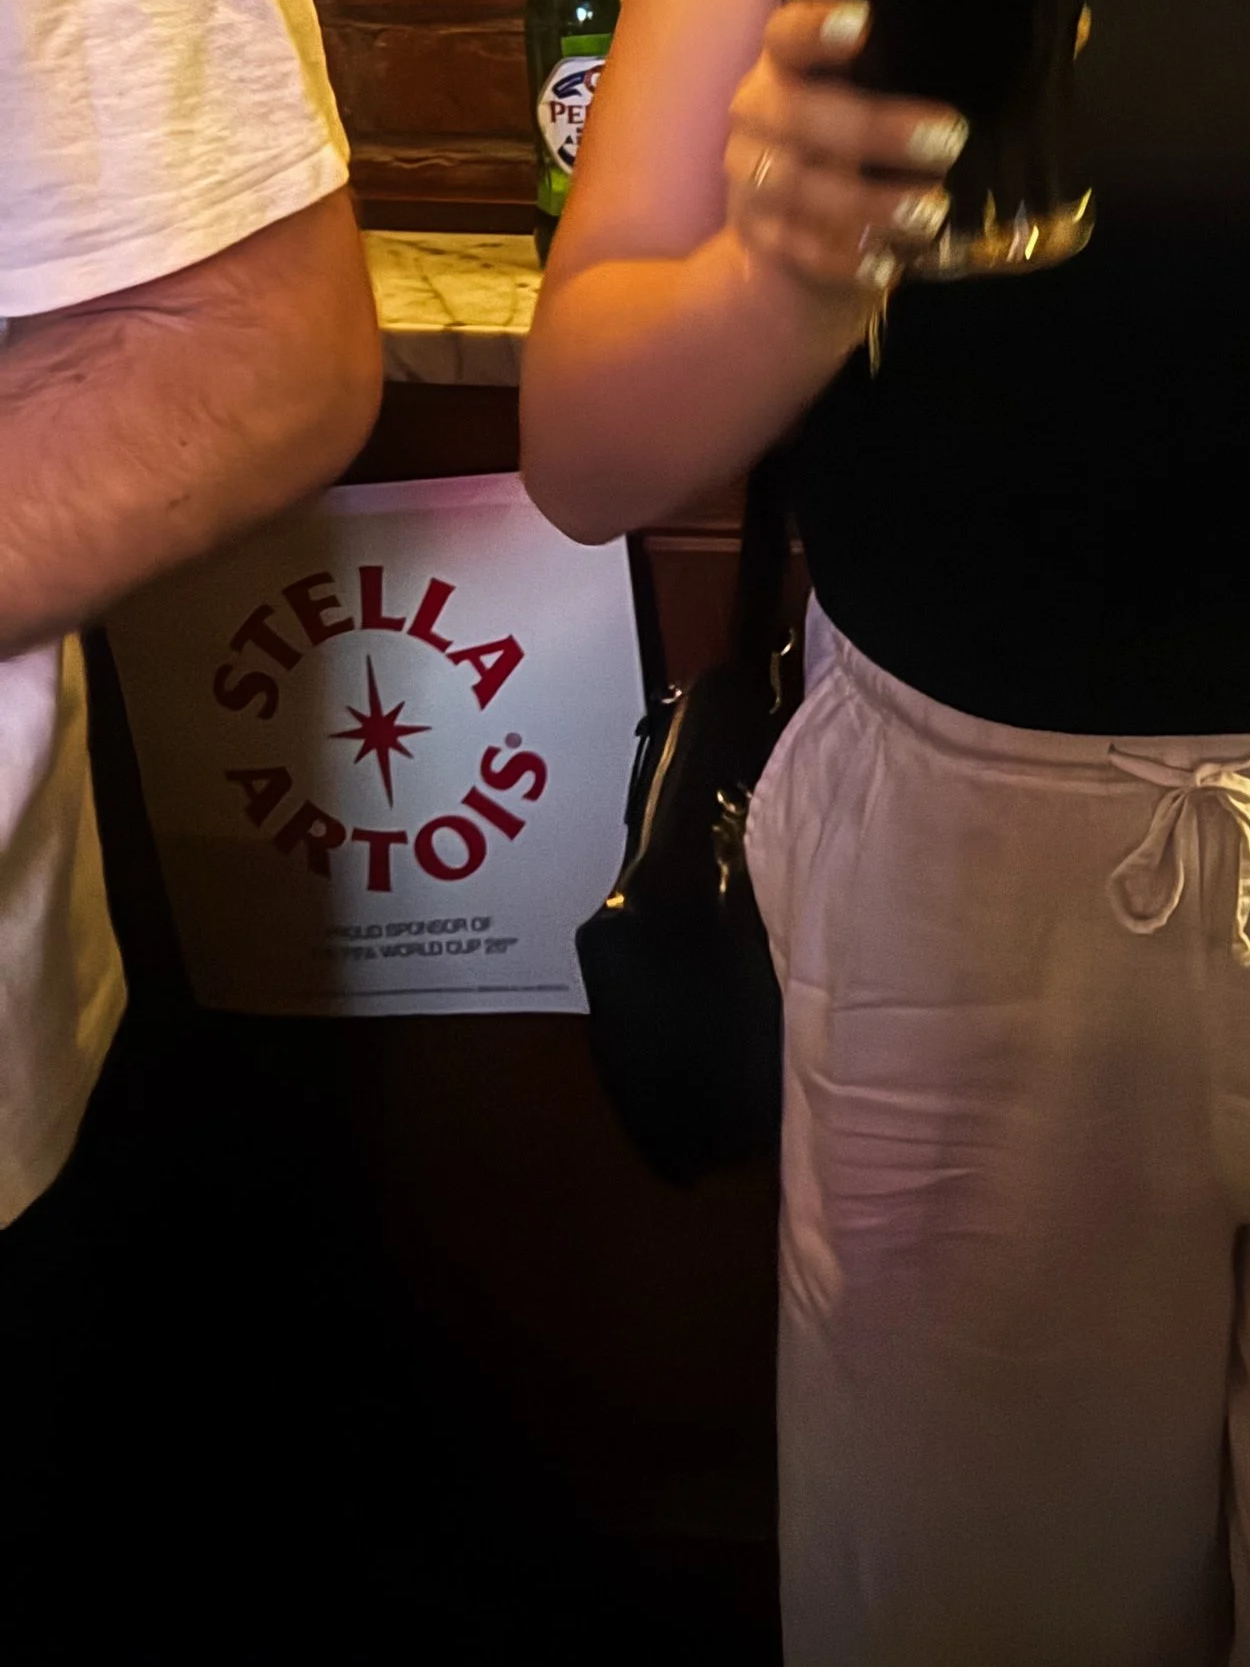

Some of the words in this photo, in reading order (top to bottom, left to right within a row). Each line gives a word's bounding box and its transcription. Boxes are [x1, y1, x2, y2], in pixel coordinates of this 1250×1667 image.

[549, 100, 587, 125] PE
[212, 565, 525, 720] STELLA
[226, 746, 549, 892] ARTOIS
